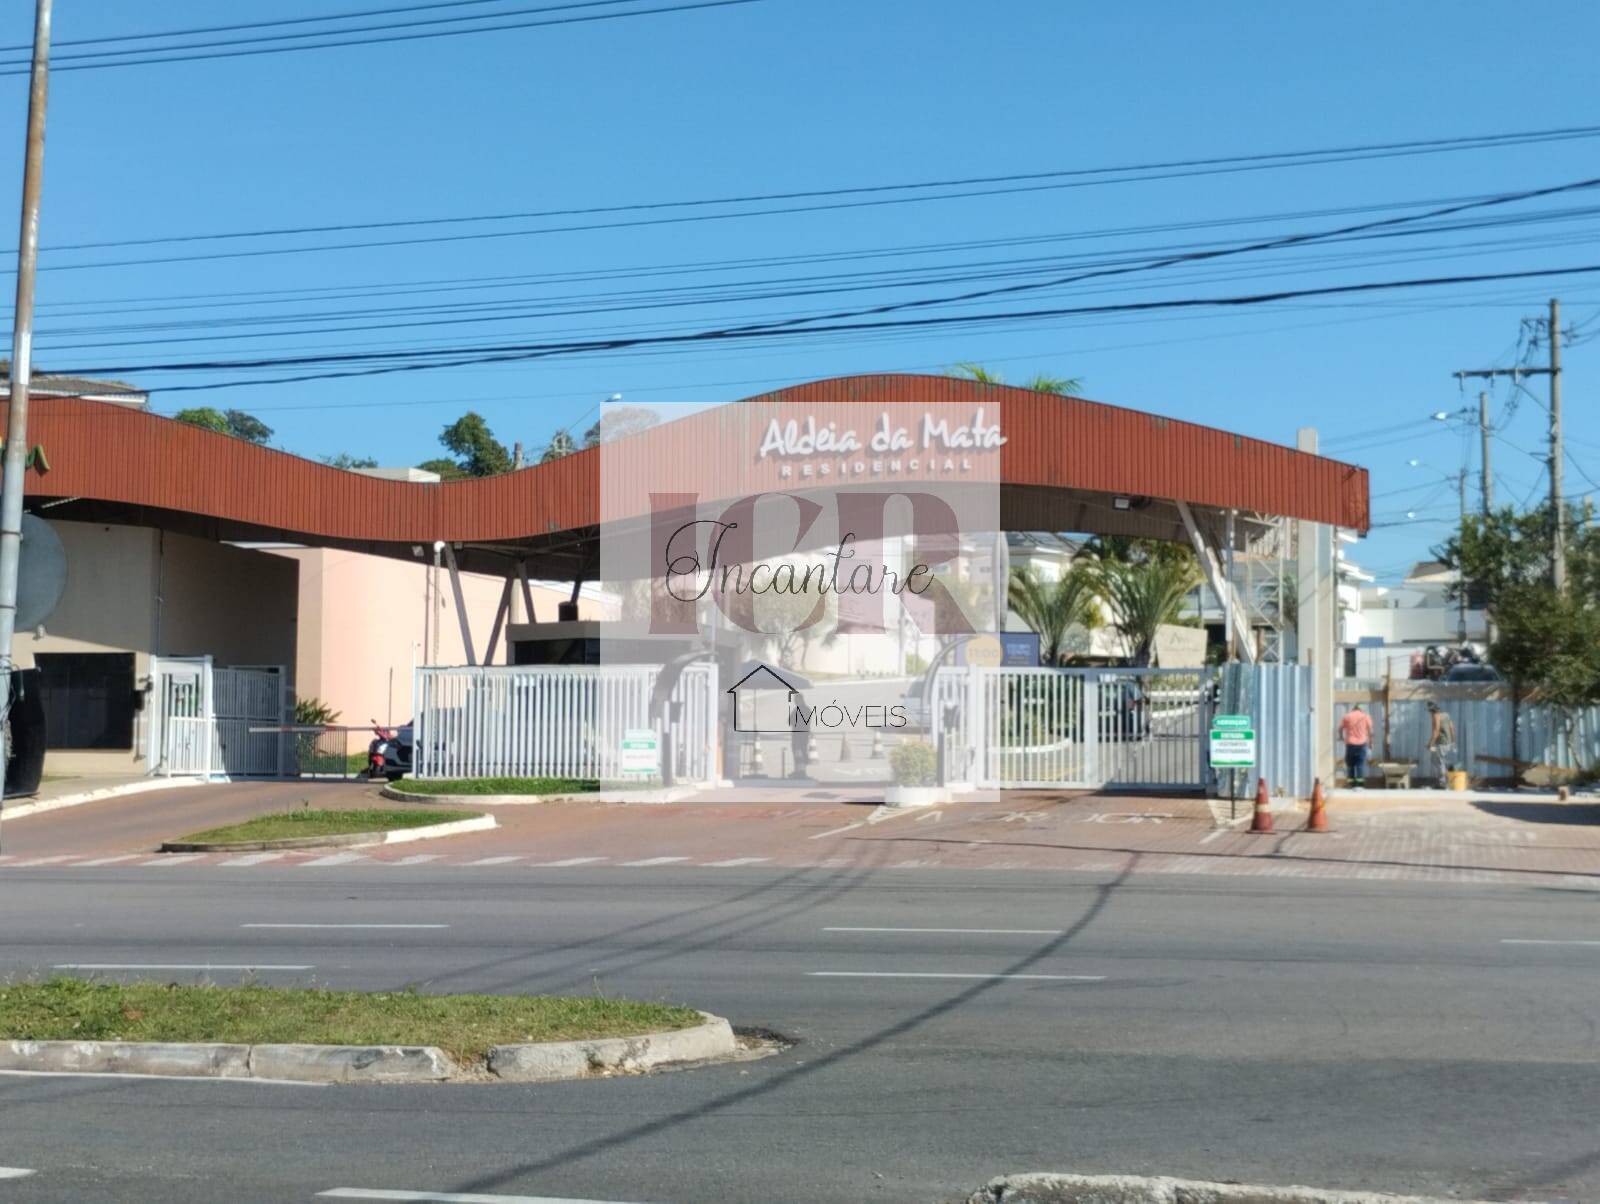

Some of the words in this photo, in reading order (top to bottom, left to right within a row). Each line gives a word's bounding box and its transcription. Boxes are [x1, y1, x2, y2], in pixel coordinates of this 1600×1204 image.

[759, 415, 862, 458] Aldeia
[871, 412, 914, 452] da
[923, 407, 1009, 449] Mata
[781, 458, 972, 476] RESIDENCIAL
